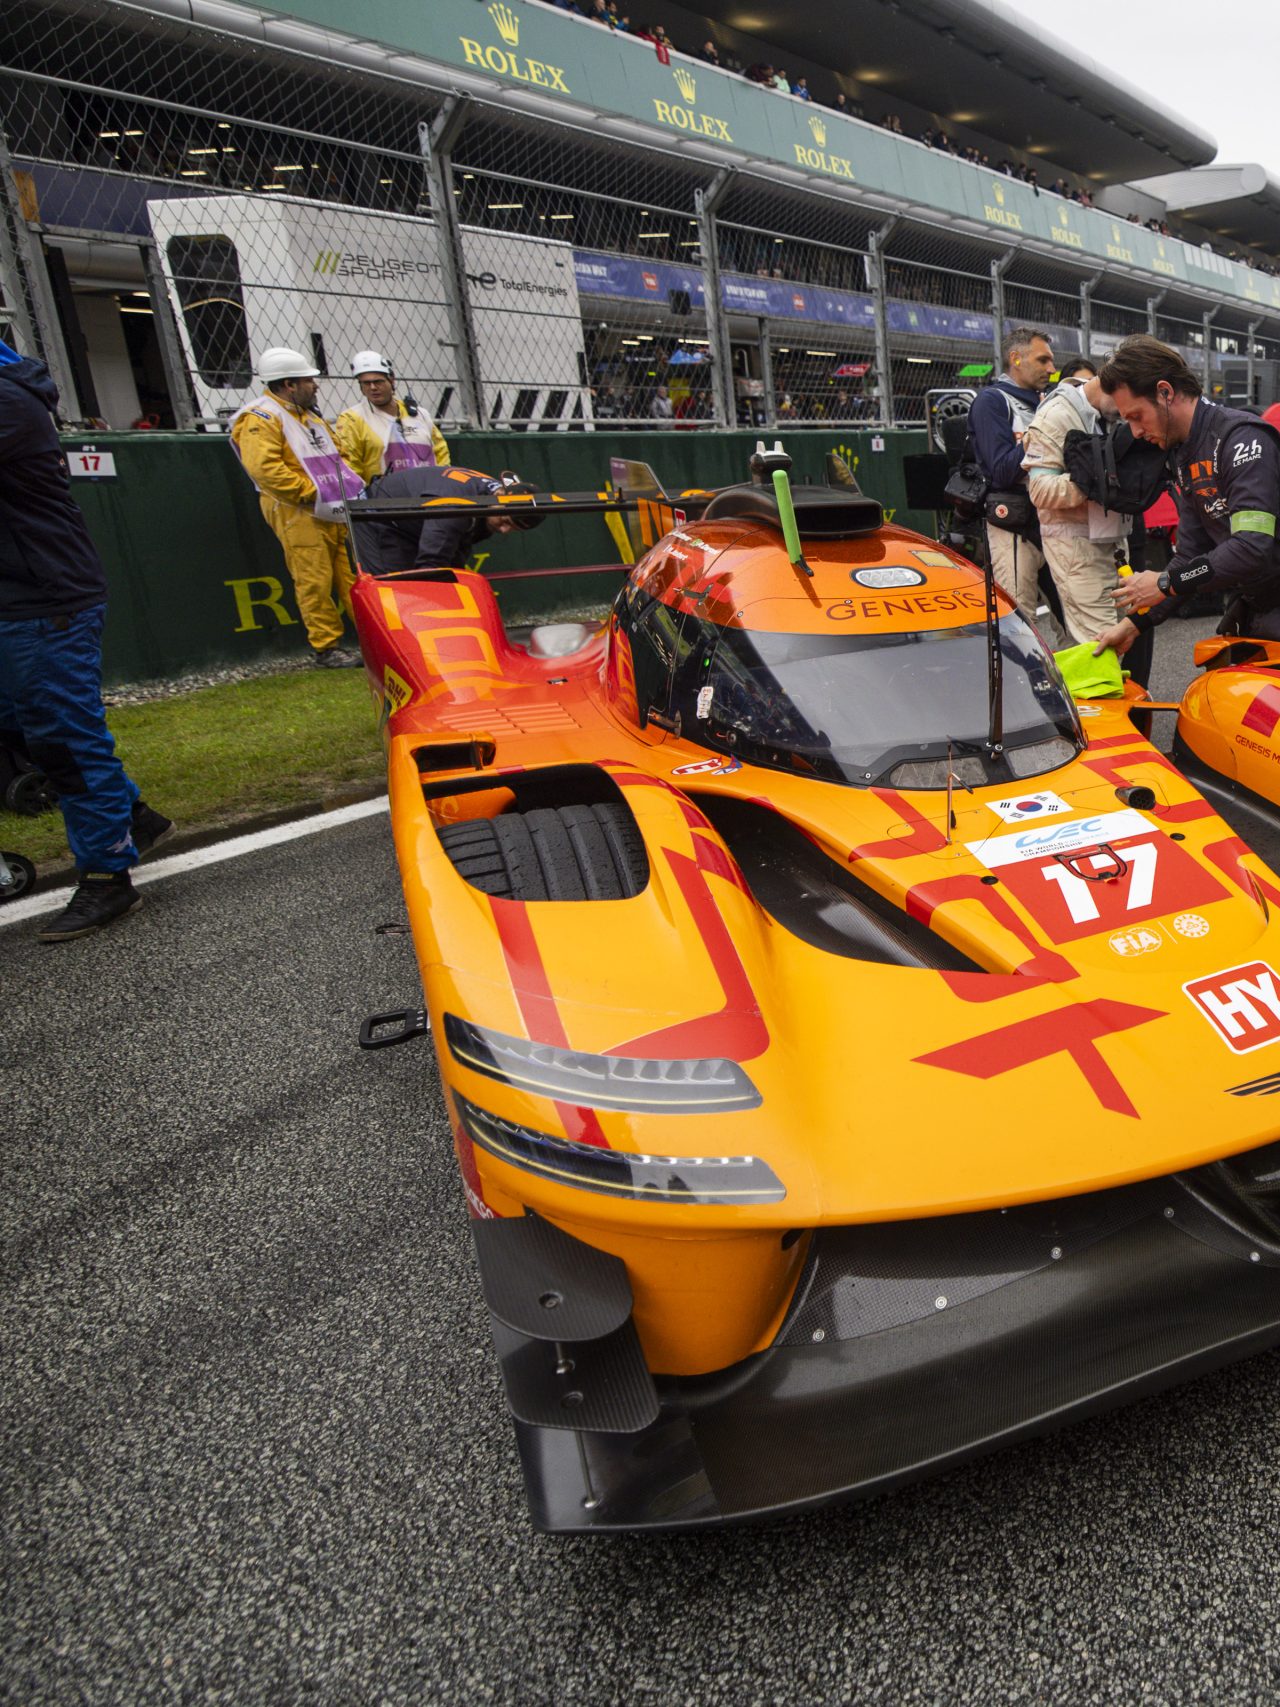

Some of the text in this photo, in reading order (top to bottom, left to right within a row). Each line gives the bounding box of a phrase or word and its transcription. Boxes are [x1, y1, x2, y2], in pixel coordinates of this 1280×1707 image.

[459, 37, 571, 94] ROLEX
[653, 99, 734, 143] ROLEX
[794, 143, 855, 181] ROLEX
[984, 205, 1023, 230] ROLEX
[1051, 226, 1083, 249] ROLEX
[337, 266, 409, 282] SPORT
[341, 253, 442, 275] PEUGEOT
[500, 278, 568, 298] TotalEnergies
[1233, 439, 1262, 461] 24h
[1242, 453, 1261, 464] MANS
[79, 455, 101, 471] 17
[826, 592, 986, 621] GENESIS
[1235, 734, 1271, 758] GENESIS
[1015, 819, 1103, 849] WEC
[1040, 842, 1158, 924] 17
[1111, 931, 1160, 955] FIA
